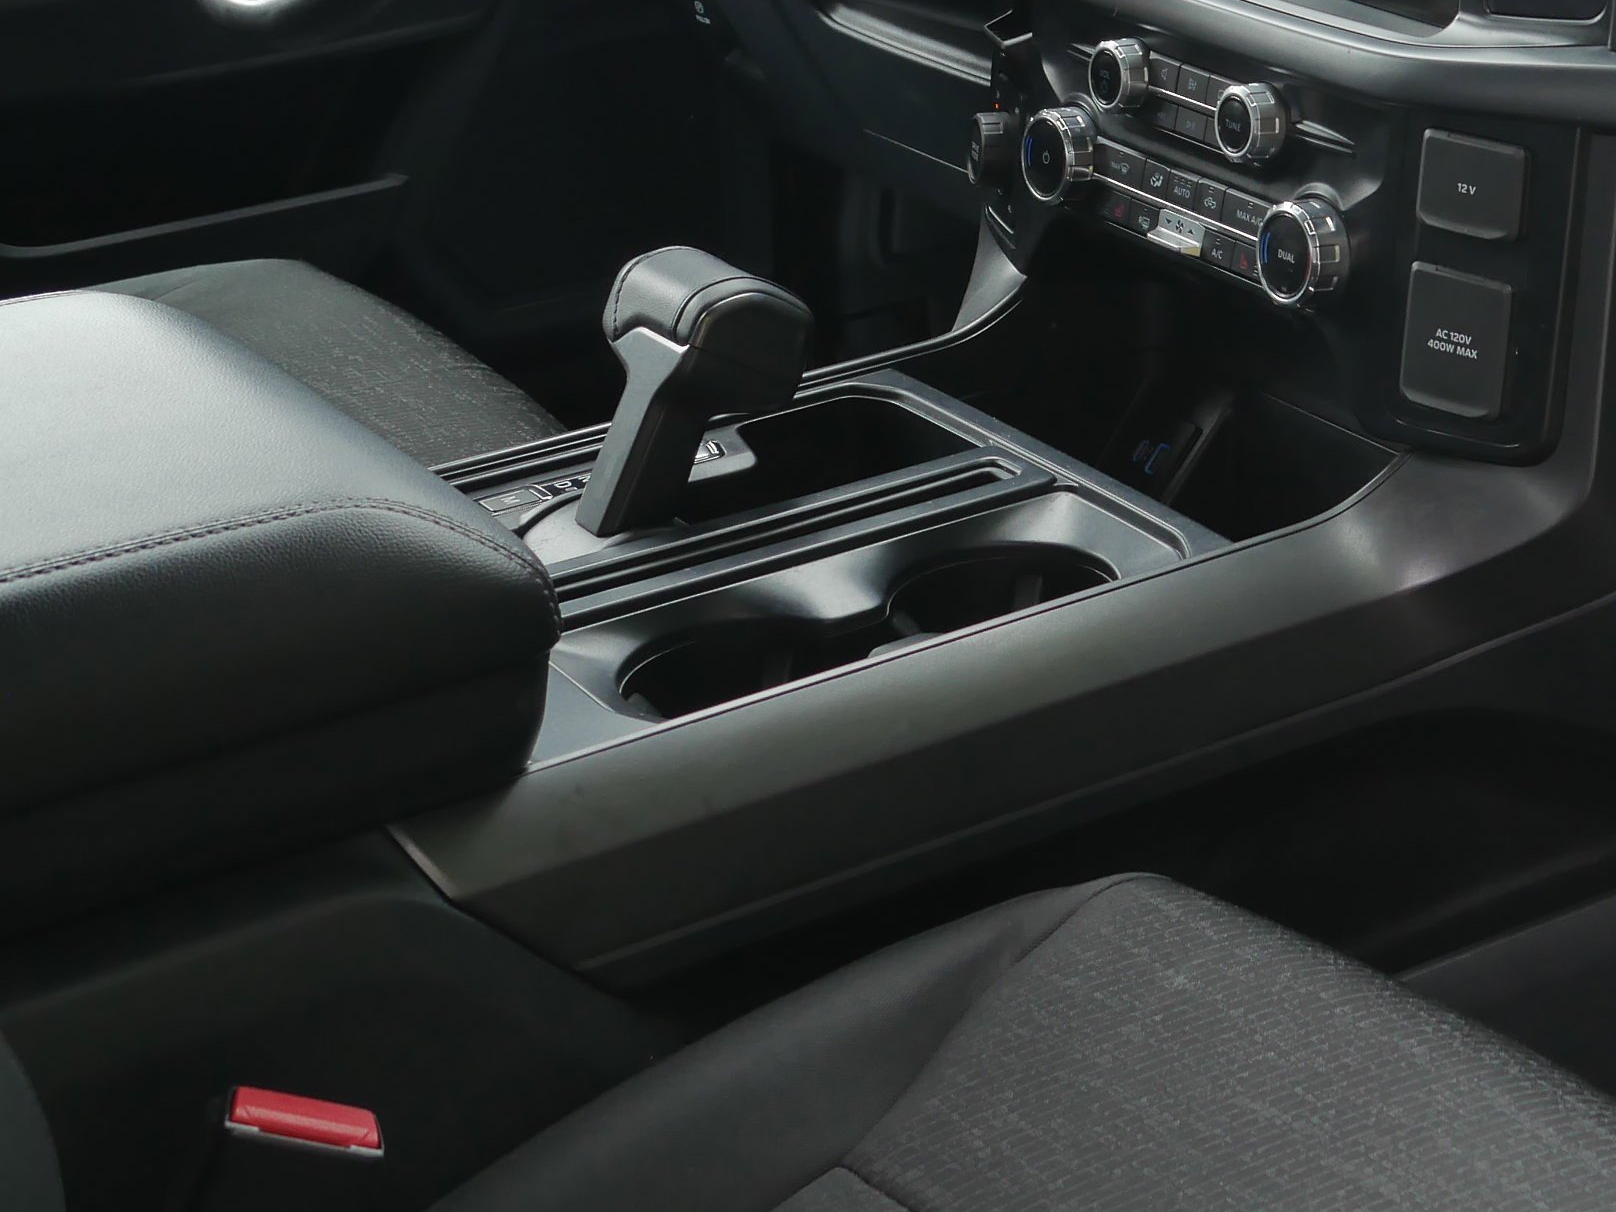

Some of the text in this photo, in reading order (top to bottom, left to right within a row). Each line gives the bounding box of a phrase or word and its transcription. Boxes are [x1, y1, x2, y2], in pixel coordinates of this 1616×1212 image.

[1225, 118, 1241, 131] TUNE
[1173, 186, 1191, 198] AUTO
[1457, 183, 1476, 195] 12 V
[1236, 209, 1251, 222] MAX
[1211, 249, 1223, 260] A/C
[1277, 249, 1295, 264] DUAL
[1435, 328, 1472, 345] AC 120V
[1427, 339, 1478, 360] 400W MAX
